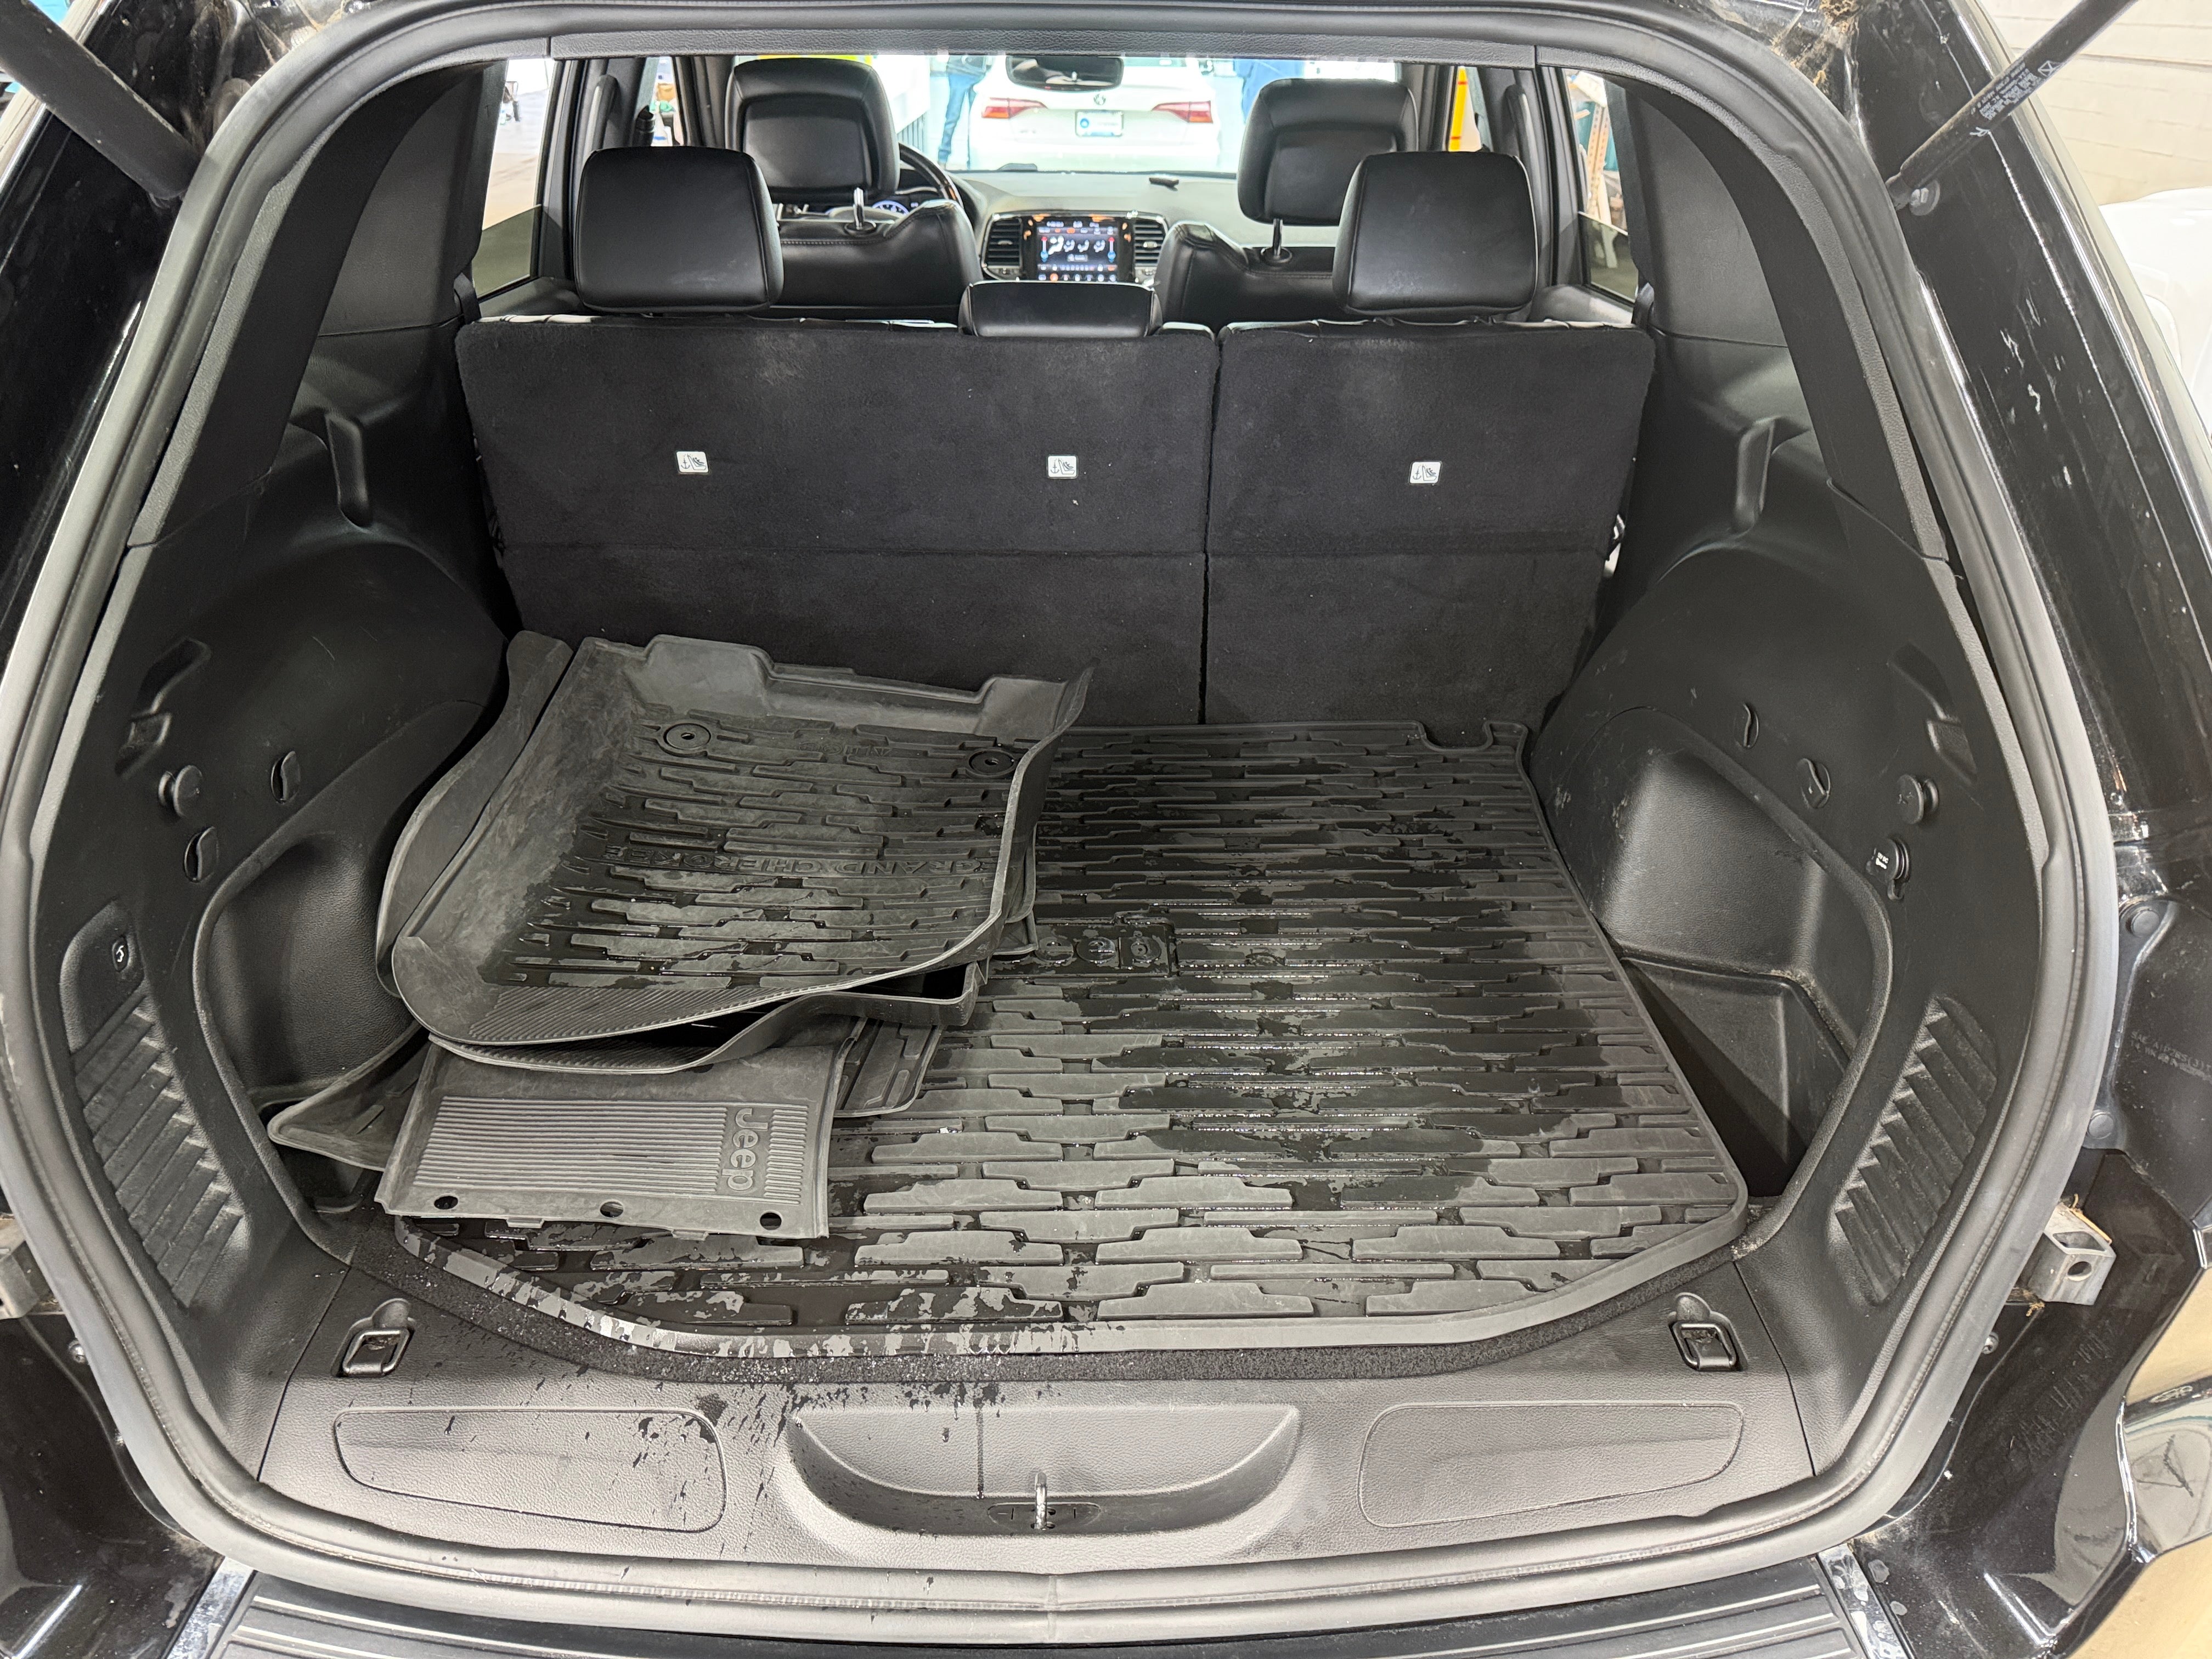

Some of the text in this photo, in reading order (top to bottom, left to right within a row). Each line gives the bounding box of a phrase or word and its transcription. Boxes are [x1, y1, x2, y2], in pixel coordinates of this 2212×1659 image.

[604, 845, 981, 874] GRAND CHEROKEE
[721, 1107, 769, 1192] Jeep
